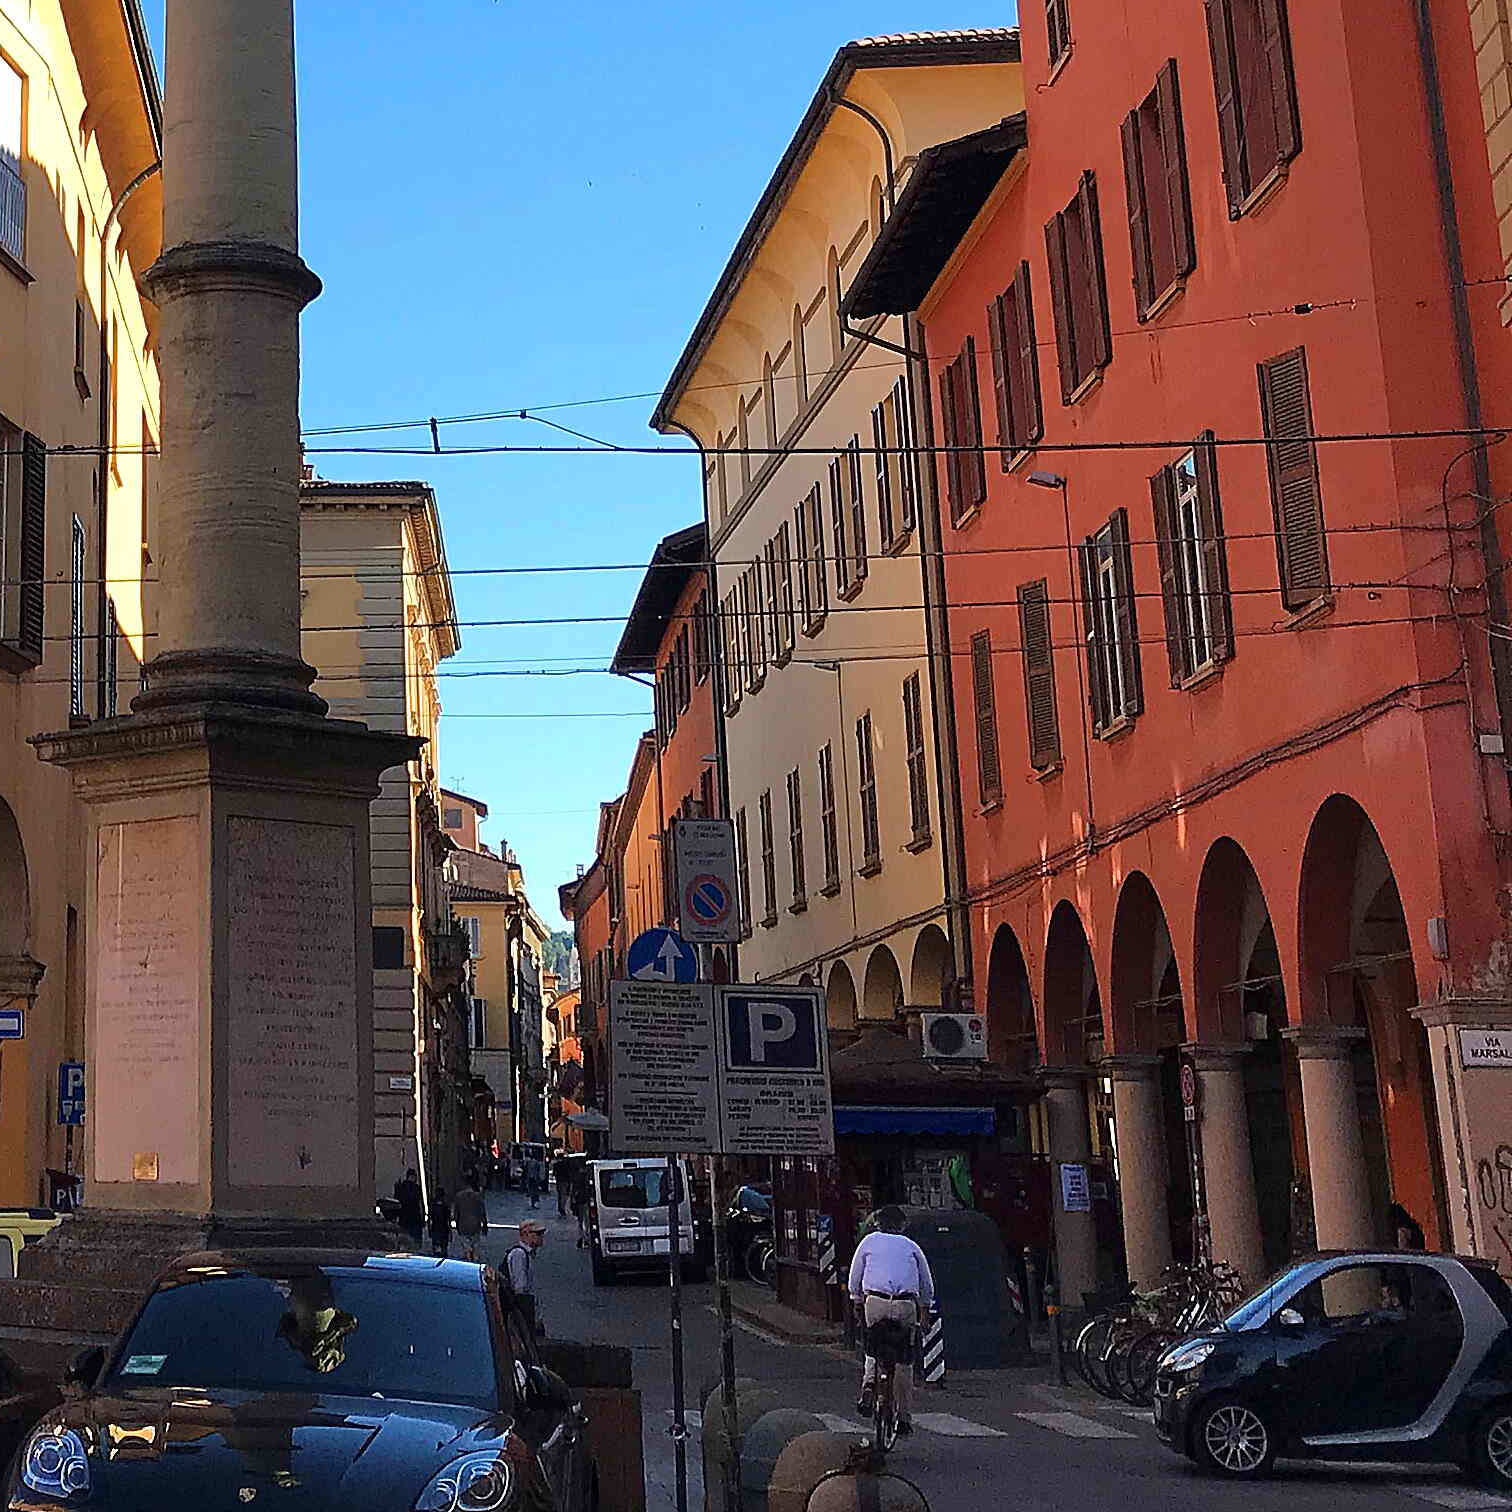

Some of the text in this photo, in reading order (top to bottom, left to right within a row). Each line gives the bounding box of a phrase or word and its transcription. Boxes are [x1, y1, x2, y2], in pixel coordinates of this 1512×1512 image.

[748, 1002, 796, 1062] P
[1484, 1037, 1501, 1047] VIA
[68, 1068, 84, 1097] P
